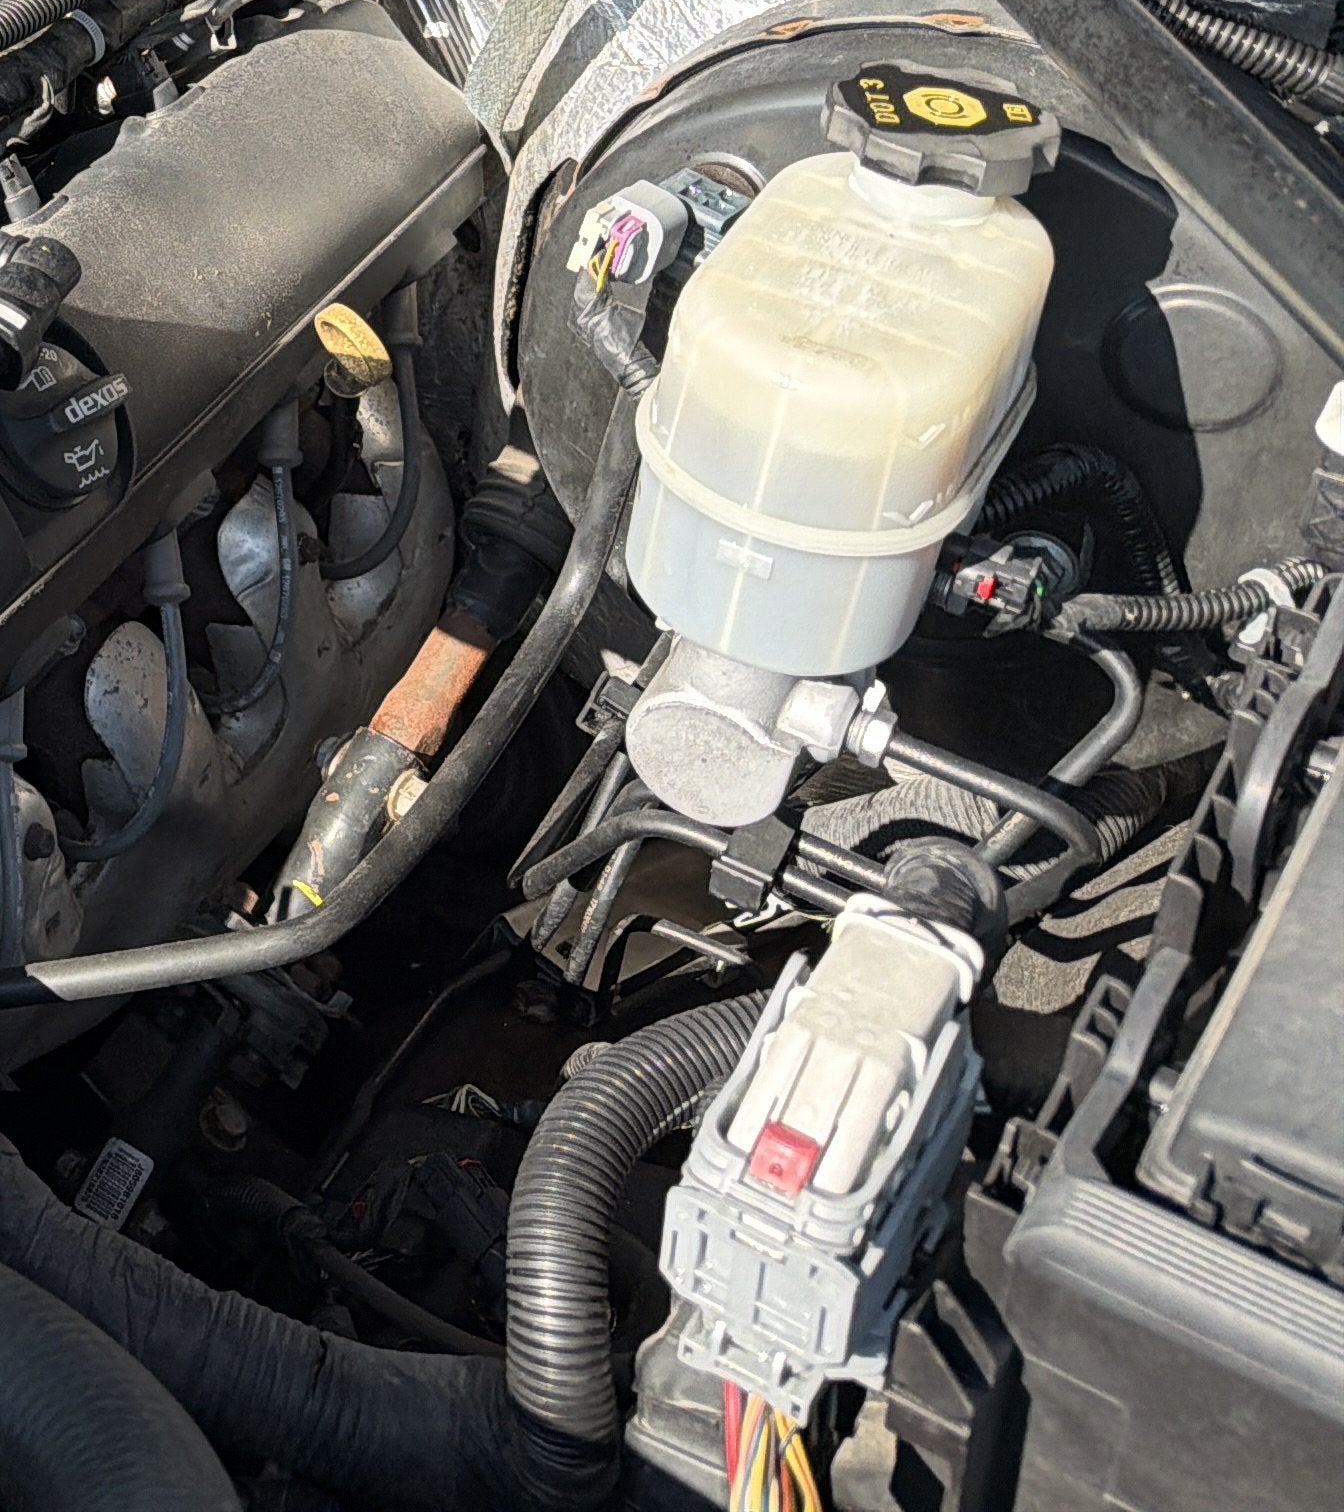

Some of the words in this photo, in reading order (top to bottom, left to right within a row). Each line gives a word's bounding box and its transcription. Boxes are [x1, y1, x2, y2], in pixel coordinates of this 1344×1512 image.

[859, 78, 885, 91] 3
[865, 91, 901, 126] DOT
[64, 378, 129, 424] dexos
